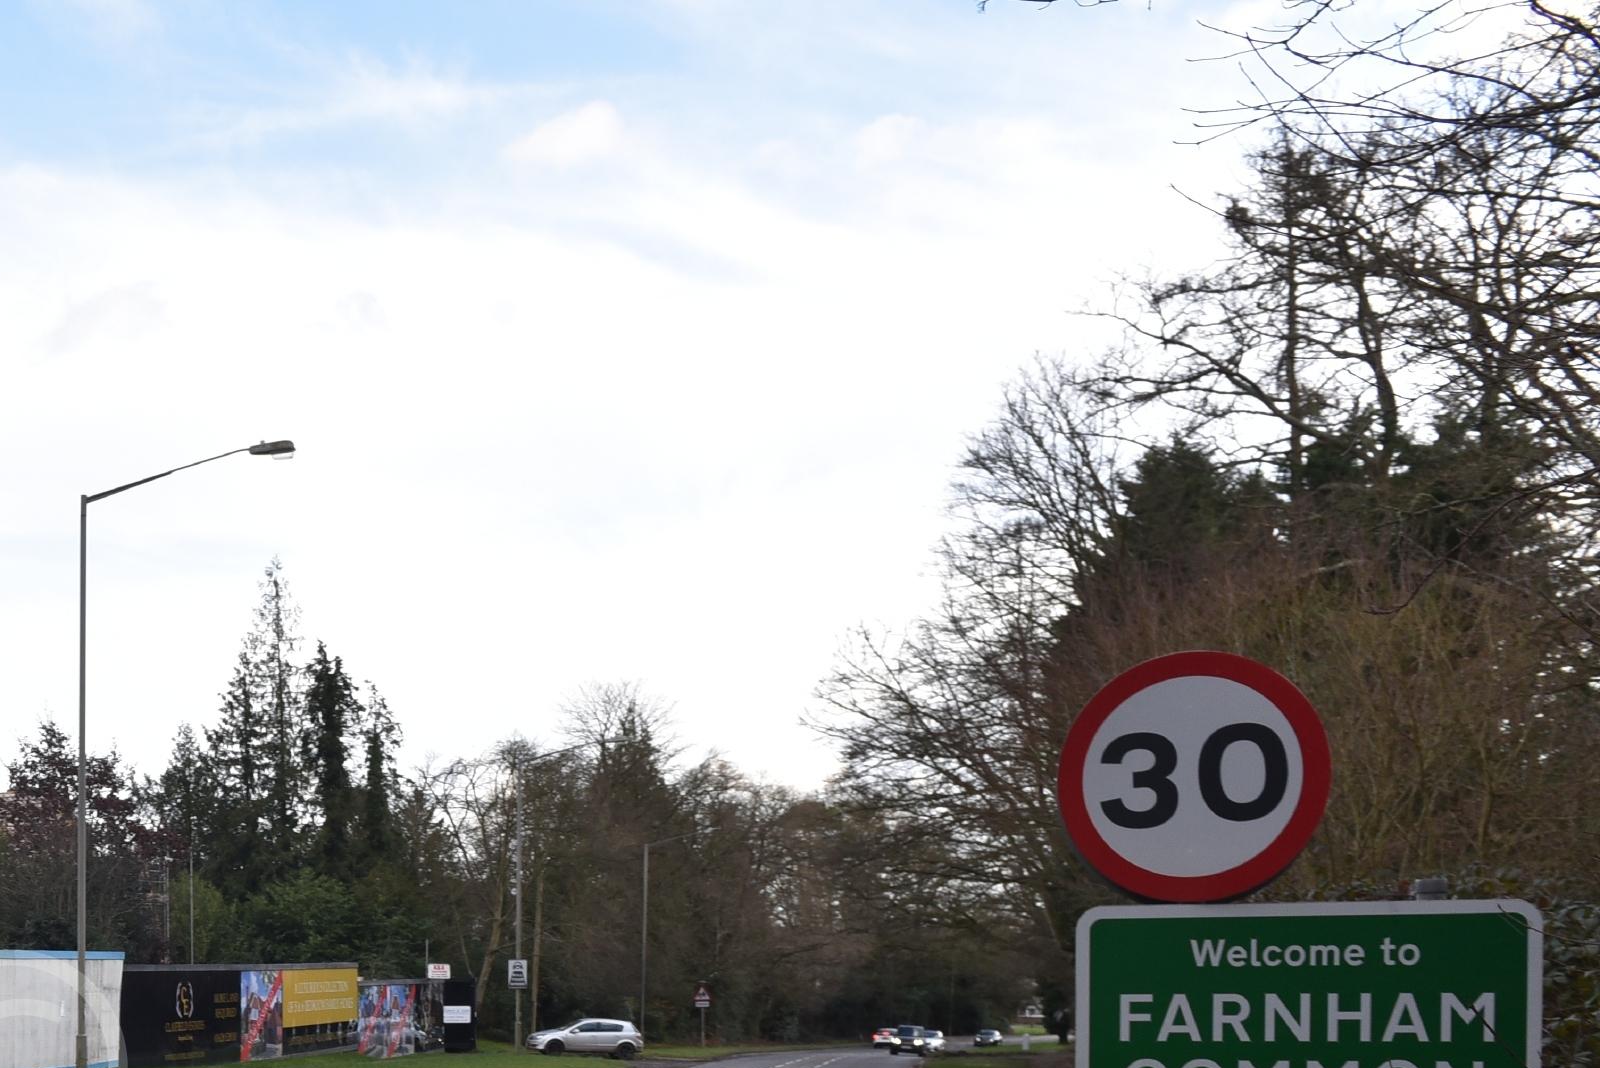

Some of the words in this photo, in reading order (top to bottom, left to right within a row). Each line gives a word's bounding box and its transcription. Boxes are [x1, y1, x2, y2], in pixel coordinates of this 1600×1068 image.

[1100, 722, 1289, 829] 30
[1190, 938, 1366, 968] Welcome
[1381, 936, 1422, 967] to
[1118, 992, 1497, 1043] FARNHAM
